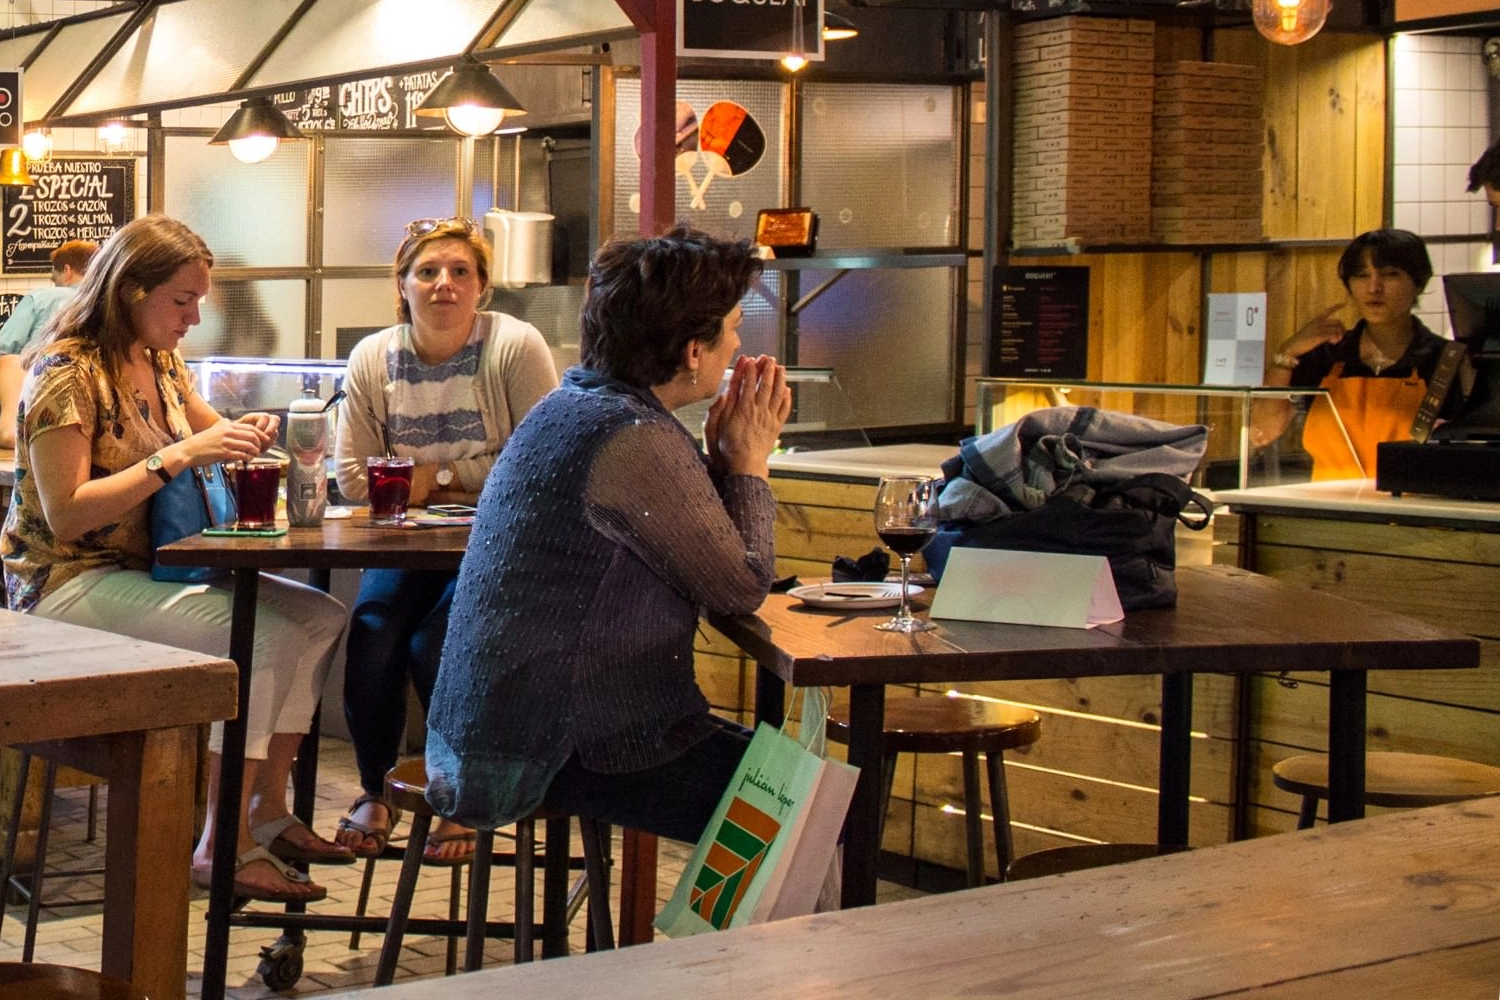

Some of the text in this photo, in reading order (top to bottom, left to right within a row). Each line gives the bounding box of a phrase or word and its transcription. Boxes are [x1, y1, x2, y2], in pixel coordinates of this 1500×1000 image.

[338, 76, 394, 117] CHIPS
[27, 161, 102, 174] PRUEBA NUESTRO
[18, 174, 114, 200] ESPECIAL
[32, 200, 69, 213] TROZOS
[6, 203, 32, 237] 2
[32, 213, 69, 226] TROZOS
[32, 227, 69, 240] TROZOS
[77, 226, 116, 239] MERLUZA
